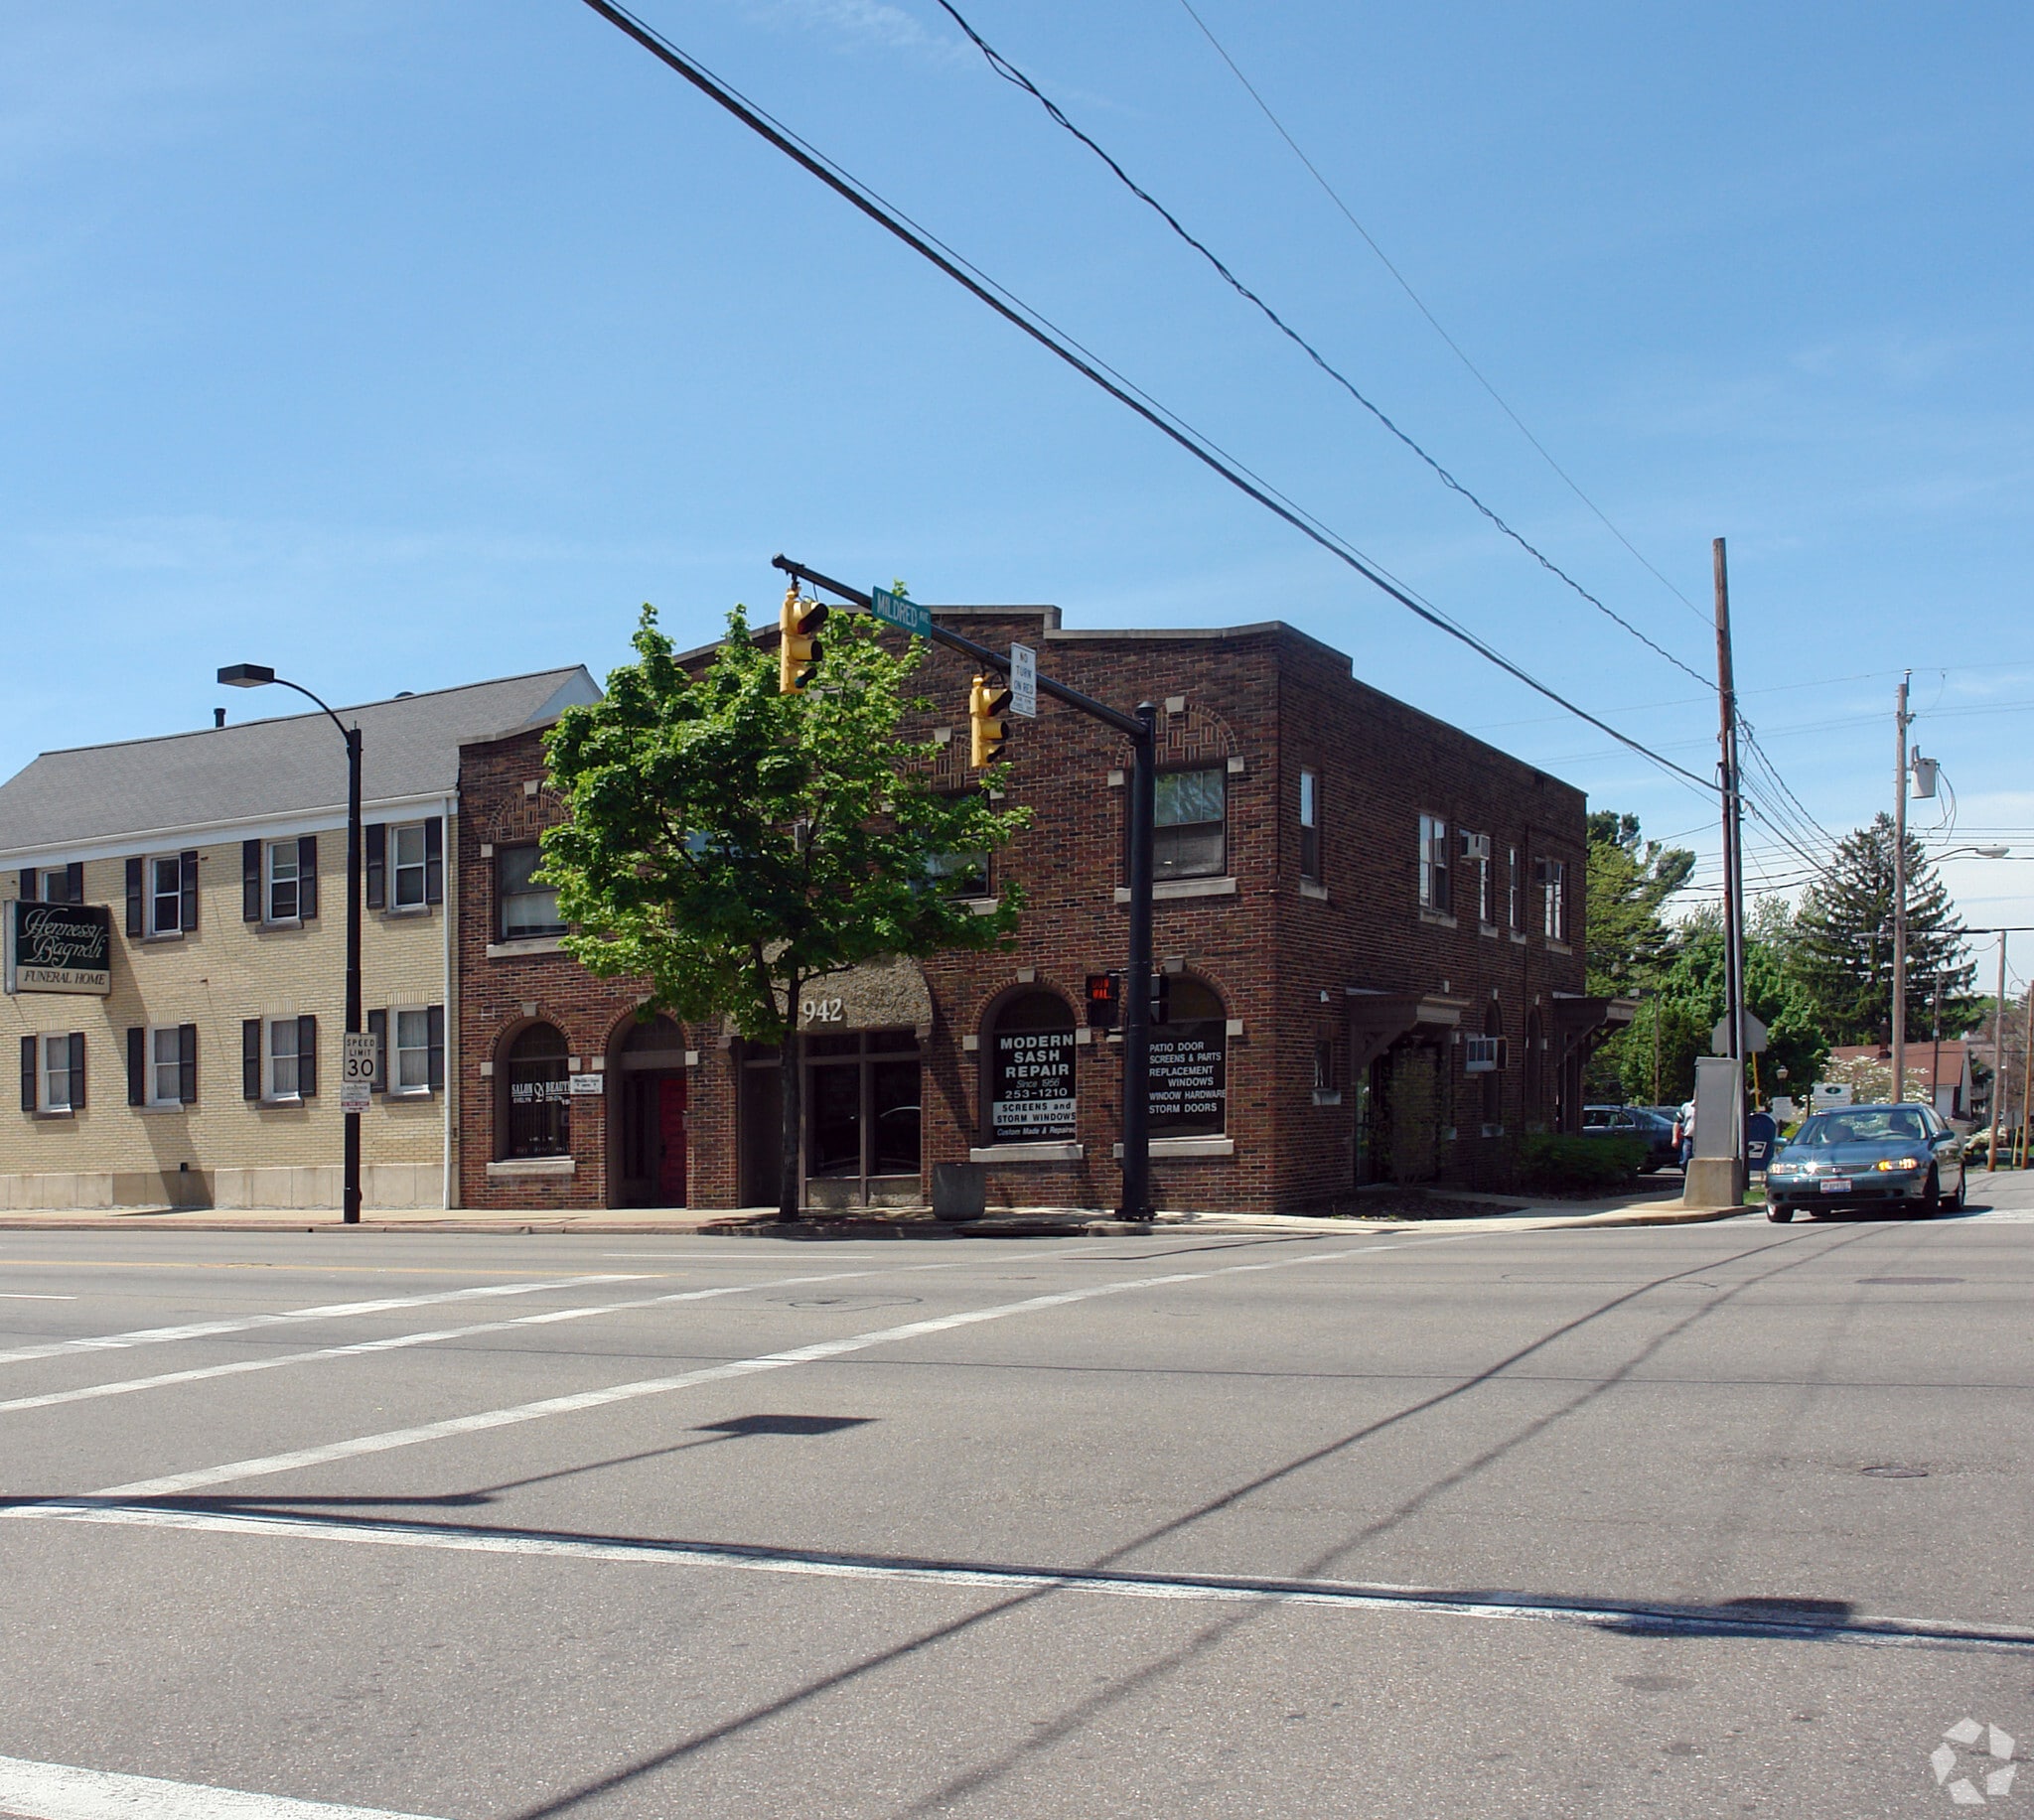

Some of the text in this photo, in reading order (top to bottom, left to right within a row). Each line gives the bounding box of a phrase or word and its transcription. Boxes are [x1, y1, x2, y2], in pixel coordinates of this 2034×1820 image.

[876, 592, 919, 628] MILDRED
[1019, 651, 1029, 663] NO
[1015, 664, 1033, 679] TURN
[1013, 680, 1034, 695] ON RED
[19, 908, 104, 948] Hennessy
[24, 934, 109, 968] Bagnoli
[24, 970, 106, 986] FUNERAL HOME
[801, 997, 843, 1024] 942
[1000, 1034, 1074, 1050] MODERN
[1149, 1041, 1205, 1052] PATIO DOOR
[1013, 1050, 1061, 1063] SASH
[1149, 1051, 1222, 1064] SCREENS & PARTS
[348, 1058, 374, 1076] 30
[1005, 1063, 1070, 1078] REPAIR
[1148, 1065, 1214, 1077] REPLACEMENT
[1016, 1079, 1038, 1088] Since
[1168, 1076, 1215, 1087] WINDOWS
[1005, 1087, 1068, 1099] 253-1210
[1148, 1089, 1226, 1101] WINDOW HARDWARE
[1002, 1101, 1072, 1112] SCREENS and
[1148, 1102, 1218, 1114] STORM DOORS
[996, 1112, 1077, 1123] STORM WINDOWS
[996, 1127, 1022, 1137] Custom
[1022, 1126, 1041, 1135] Made
